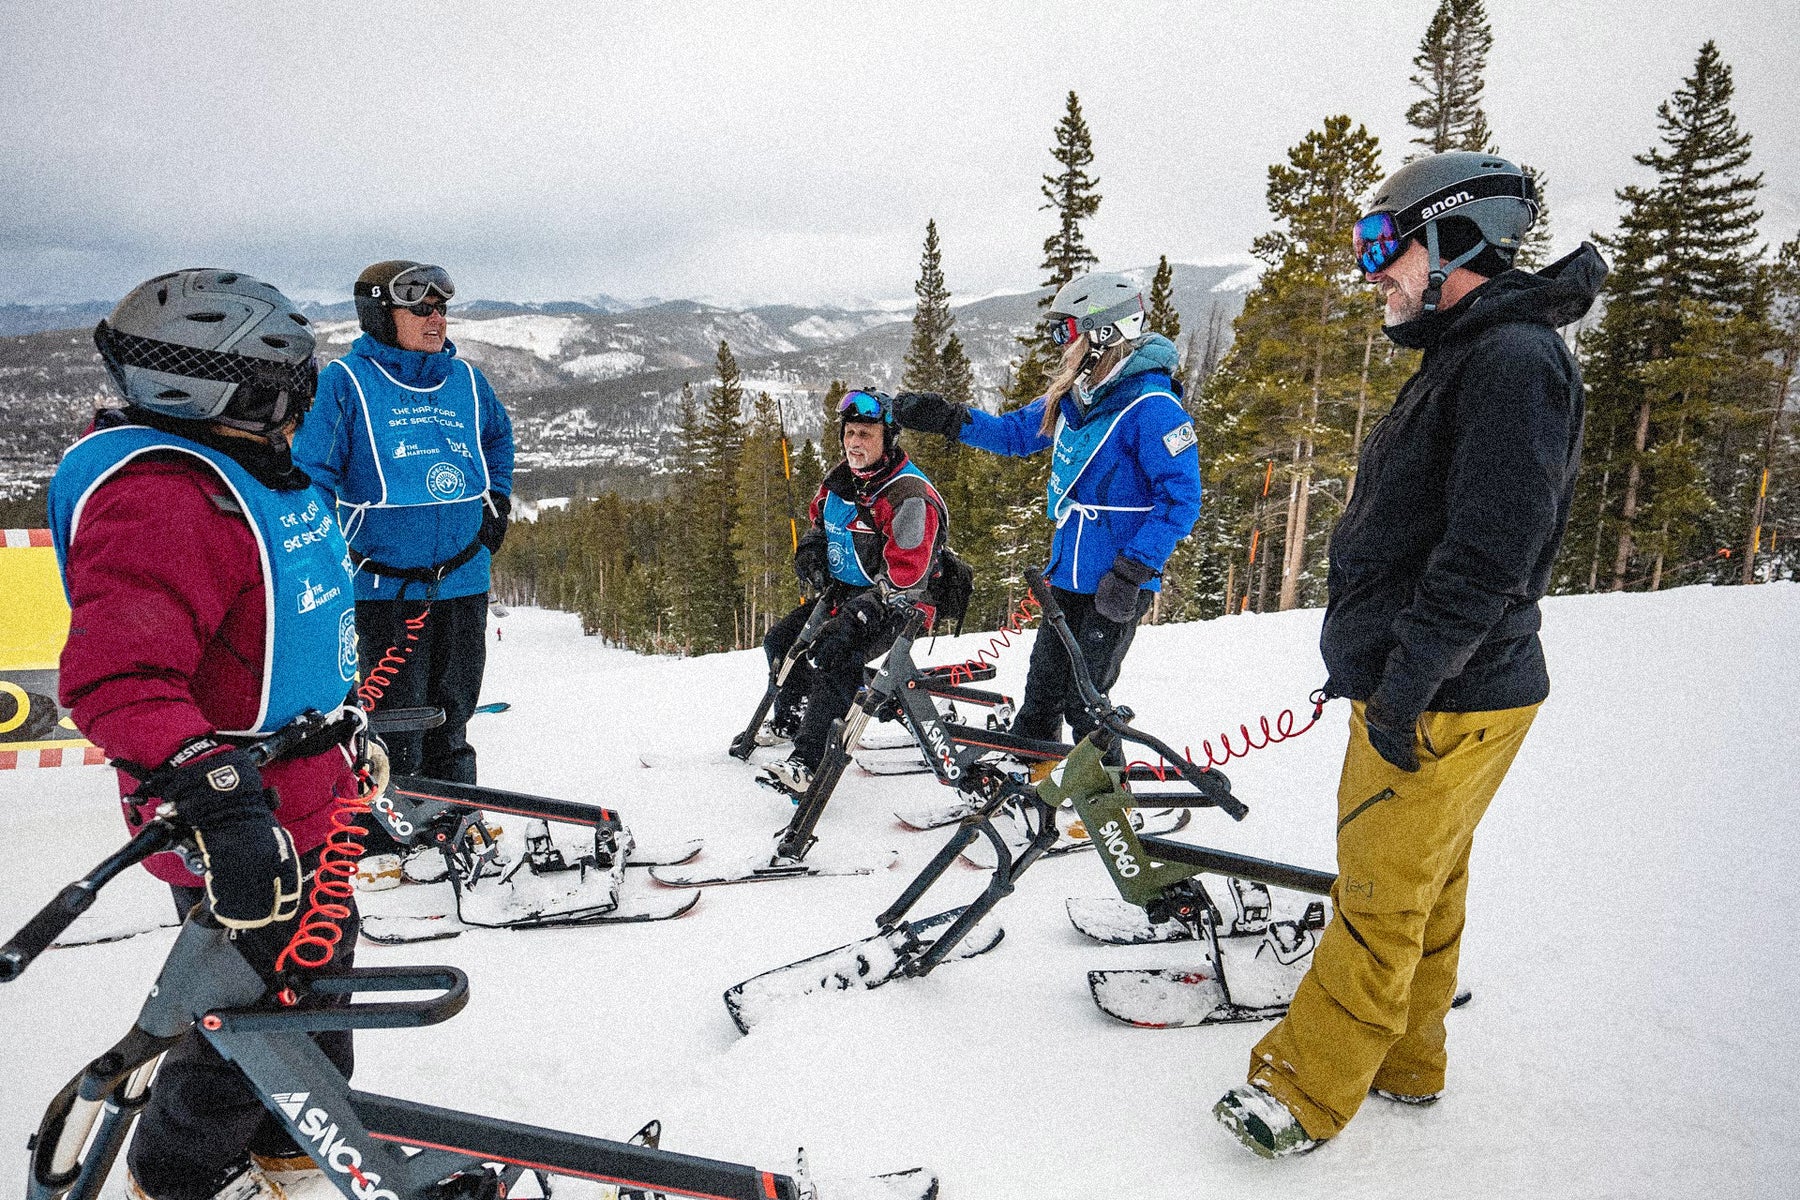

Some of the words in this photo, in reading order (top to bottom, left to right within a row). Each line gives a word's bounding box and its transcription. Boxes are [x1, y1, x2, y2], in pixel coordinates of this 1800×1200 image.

[1421, 191, 1475, 220] anon.
[412, 405, 456, 417] HARFORD
[388, 419, 409, 427] SKI
[411, 415, 465, 429] SPECTCULAR
[406, 443, 419, 451] THE
[406, 447, 441, 457] HARTFORD
[315, 586, 341, 607] HARTFOR
